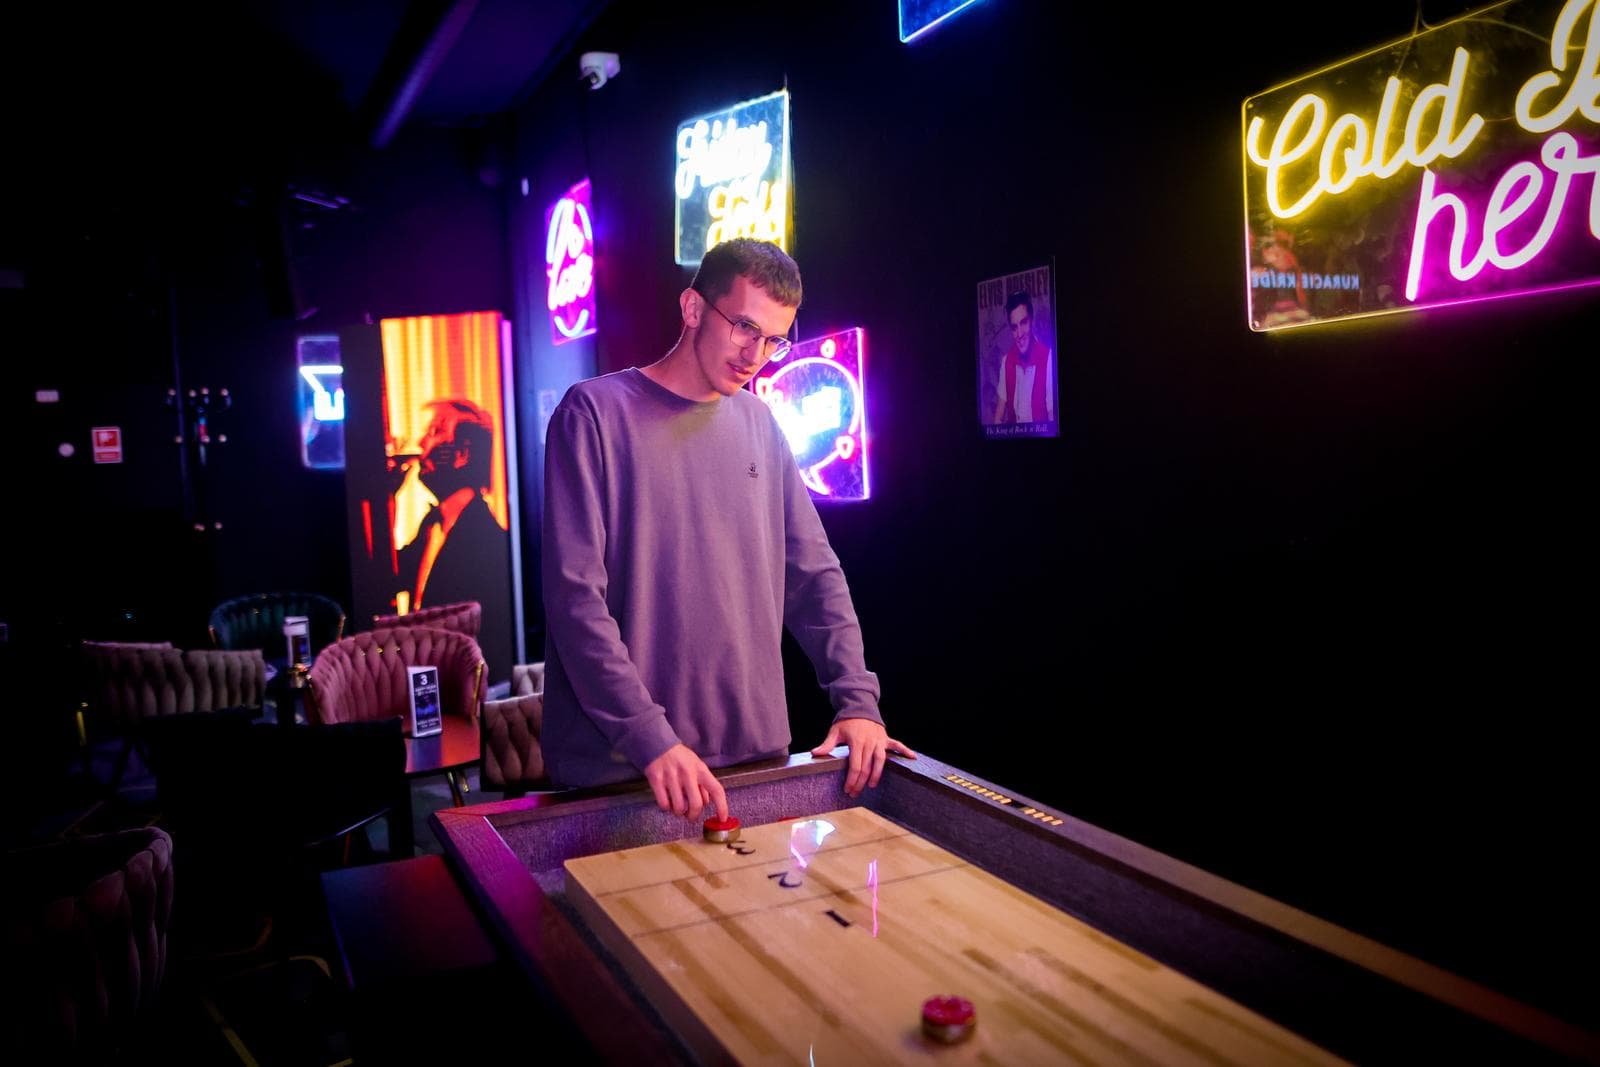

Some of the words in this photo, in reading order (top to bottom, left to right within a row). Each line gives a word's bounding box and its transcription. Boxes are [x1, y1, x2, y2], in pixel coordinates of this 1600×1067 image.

[1246, 46, 1486, 219] Cold
[979, 278, 1003, 309] ELVIS
[995, 425, 1008, 436] King
[1015, 424, 1027, 434] Rock
[420, 673, 428, 685] 3
[767, 870, 803, 889] 2
